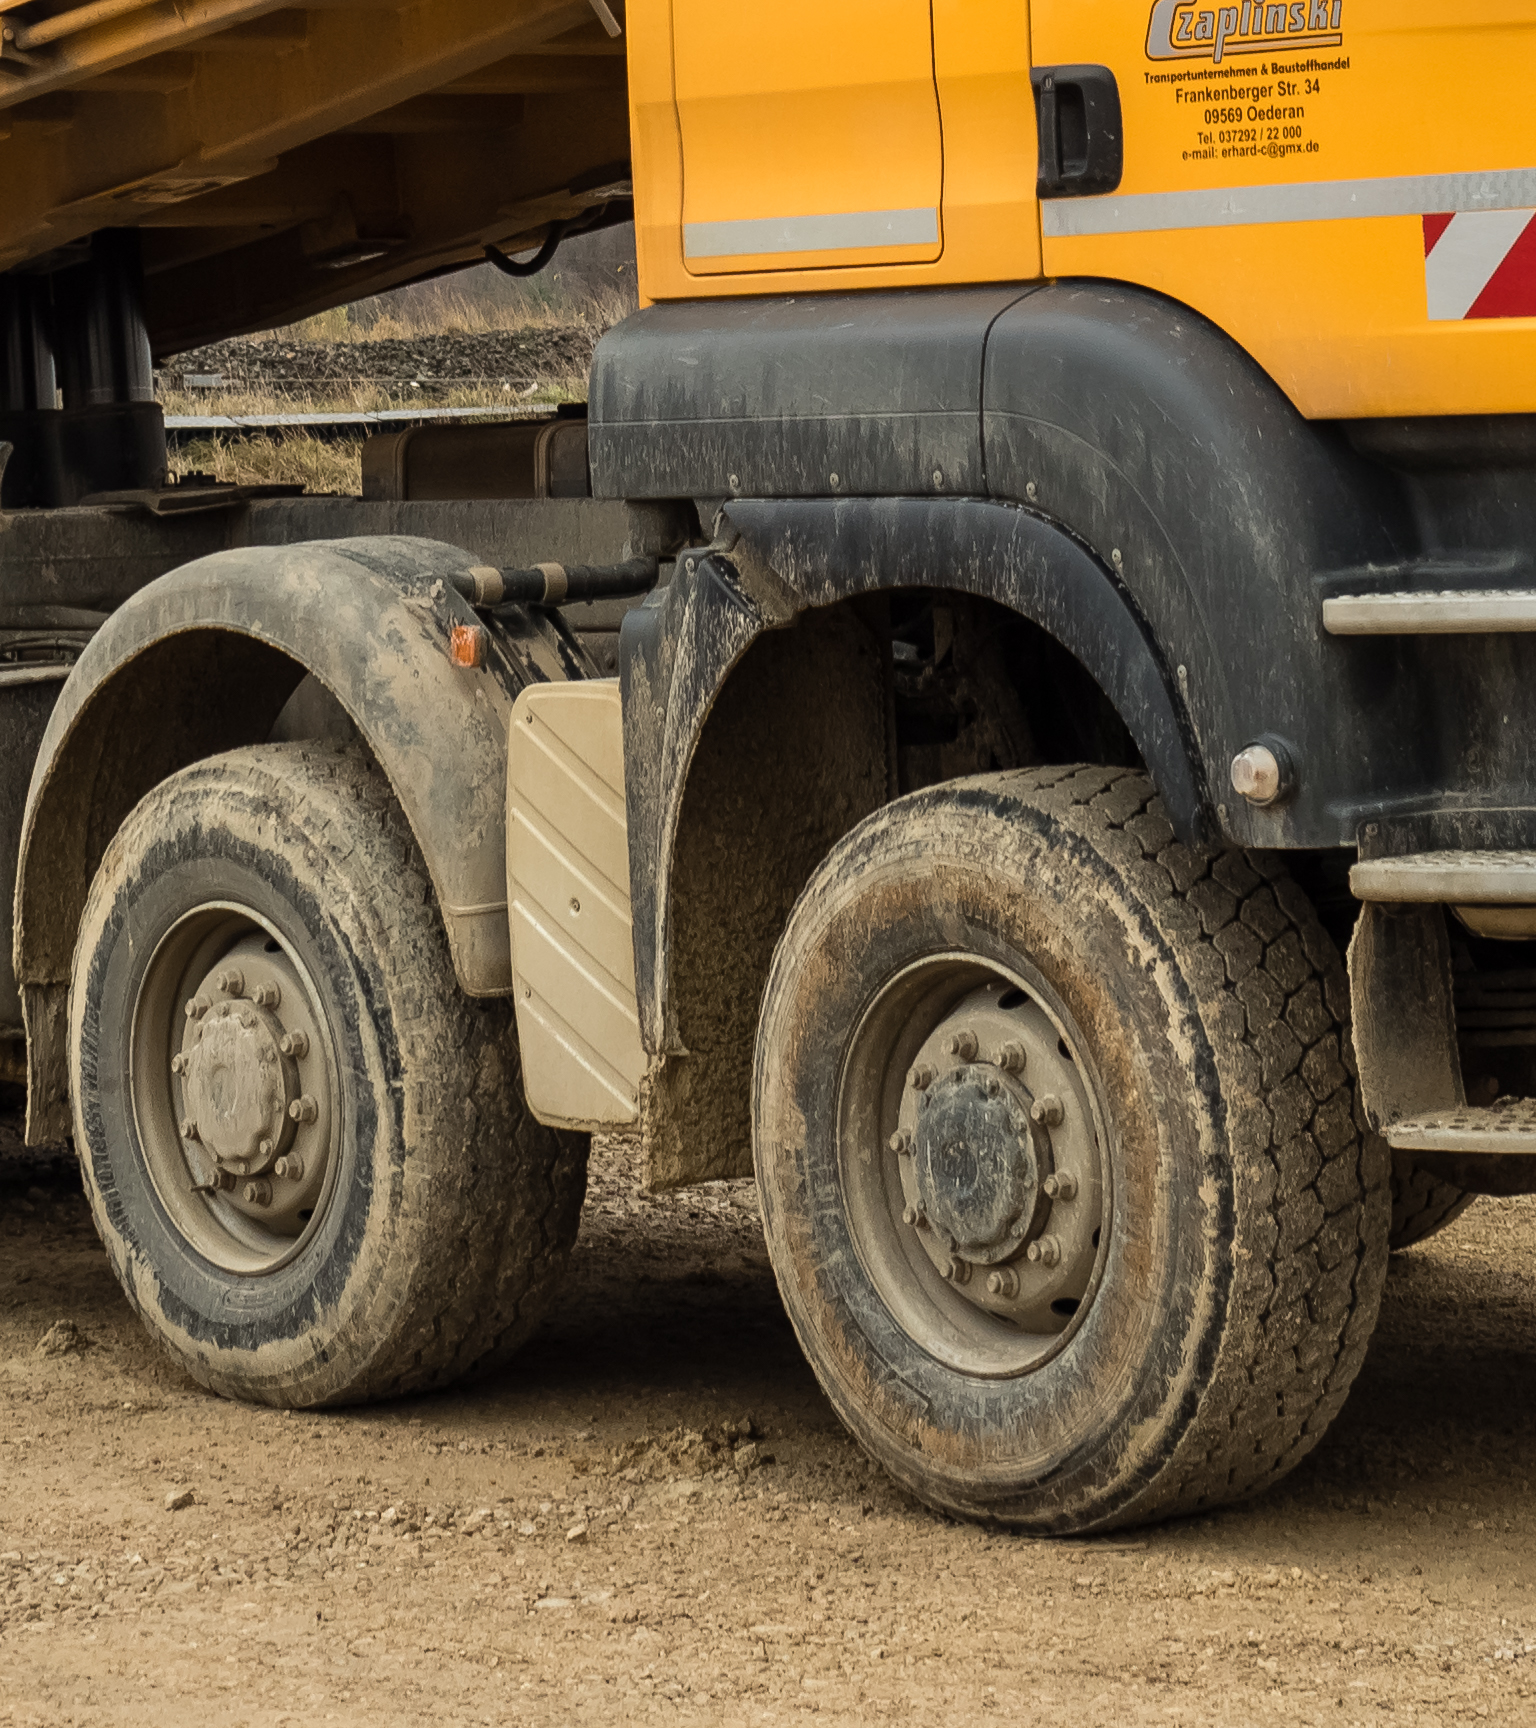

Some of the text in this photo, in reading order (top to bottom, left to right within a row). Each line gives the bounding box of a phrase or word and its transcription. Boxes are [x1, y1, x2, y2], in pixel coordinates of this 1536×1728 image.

[1143, 57, 1351, 85] Transportunternehmen & Baustoffhandel
[1175, 78, 1321, 104] Frankenberger Str. 34
[1204, 105, 1305, 125] 09569 Oederan
[1197, 131, 1216, 145] Tel.
[1218, 128, 1257, 144] 037292
[1266, 127, 1280, 140] 22
[1282, 125, 1302, 139] 000
[1181, 140, 1320, 161] e-mail: erhard-c@gmx.de
